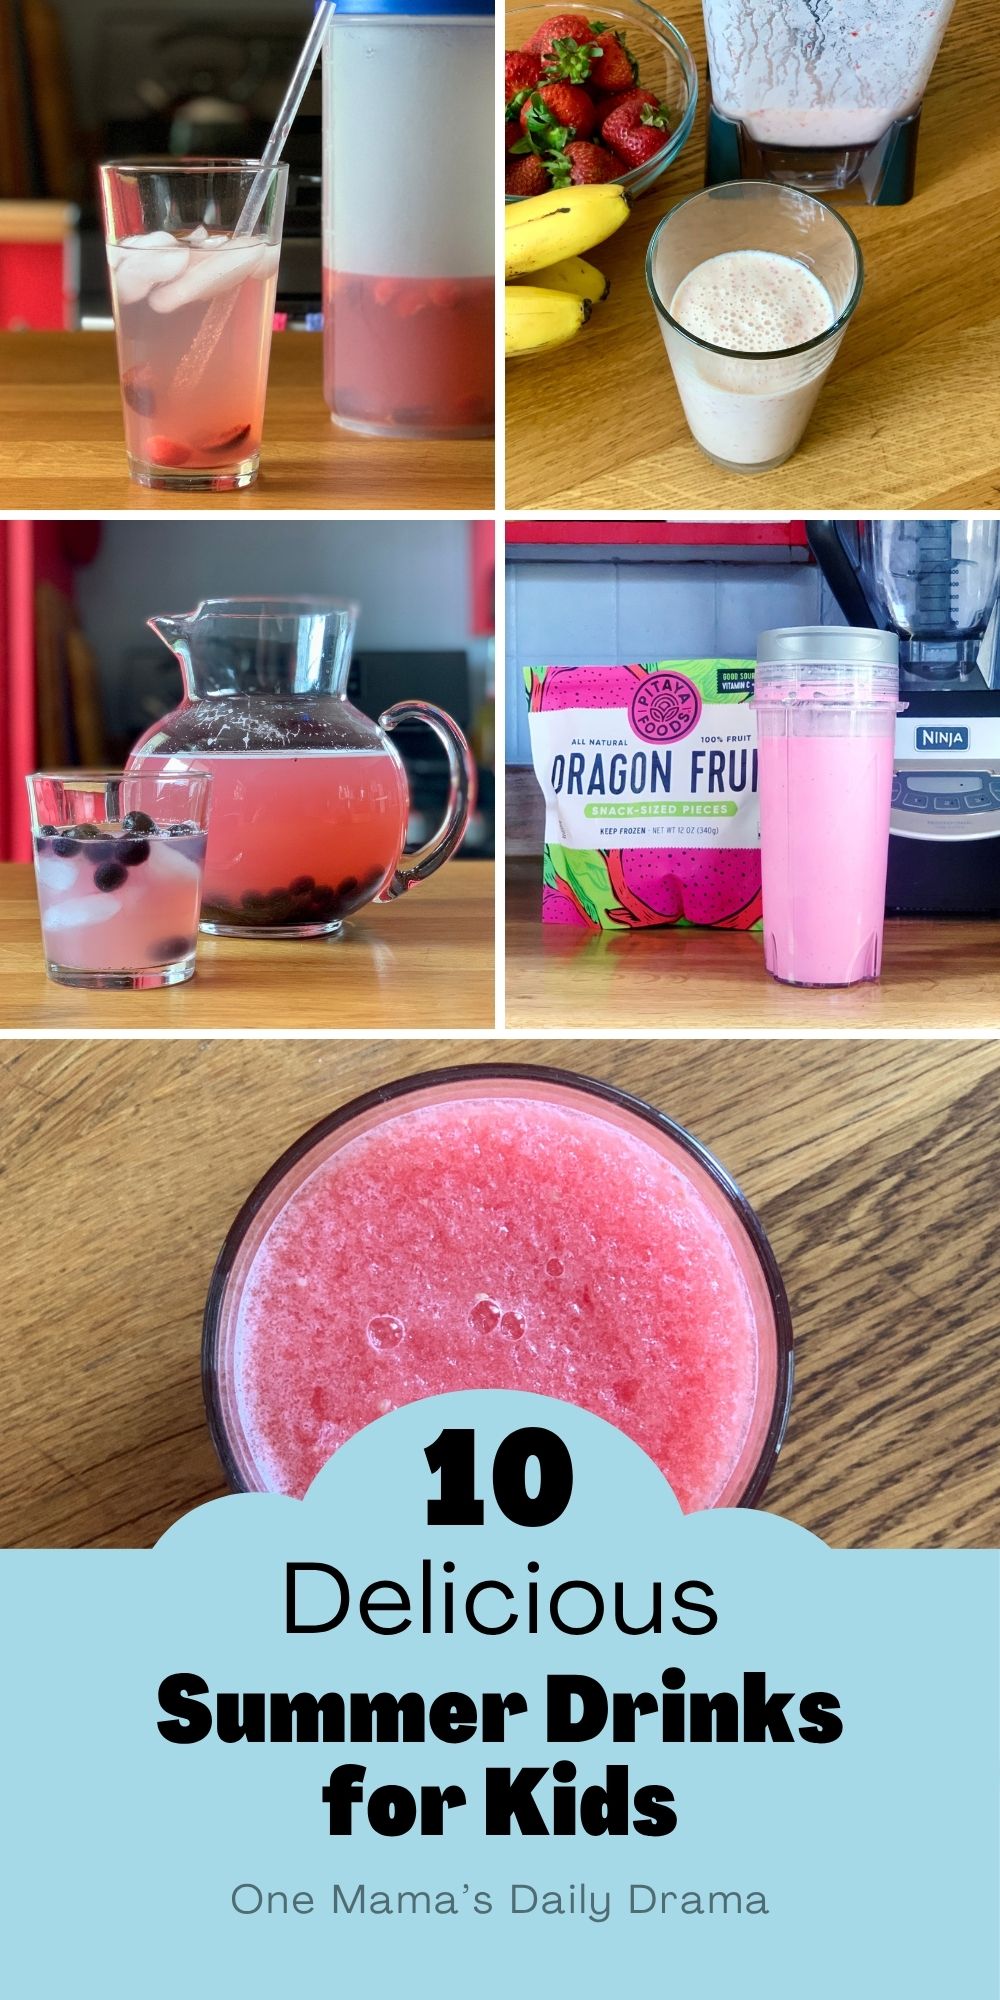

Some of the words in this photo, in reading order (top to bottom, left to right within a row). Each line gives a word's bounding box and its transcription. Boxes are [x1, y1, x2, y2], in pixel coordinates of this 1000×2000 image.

[722, 672, 739, 681] GOOD
[722, 681, 746, 690] VITAMIN
[638, 679, 691, 706] PITAYA
[637, 712, 690, 736] FOODS
[571, 738, 586, 746] ALL
[589, 739, 628, 747] NATURAL
[726, 734, 752, 743] FRUIT
[922, 729, 963, 748] NINJA
[551, 750, 672, 796] DRAGON
[591, 804, 677, 816] SNACK-SIZED
[682, 804, 728, 815] PIECES
[600, 827, 618, 836] KEEP
[619, 826, 646, 836] FROZEN
[652, 826, 665, 835] NET
[666, 826, 676, 835] WT
[678, 826, 684, 834] 12
[686, 826, 695, 835] OZ
